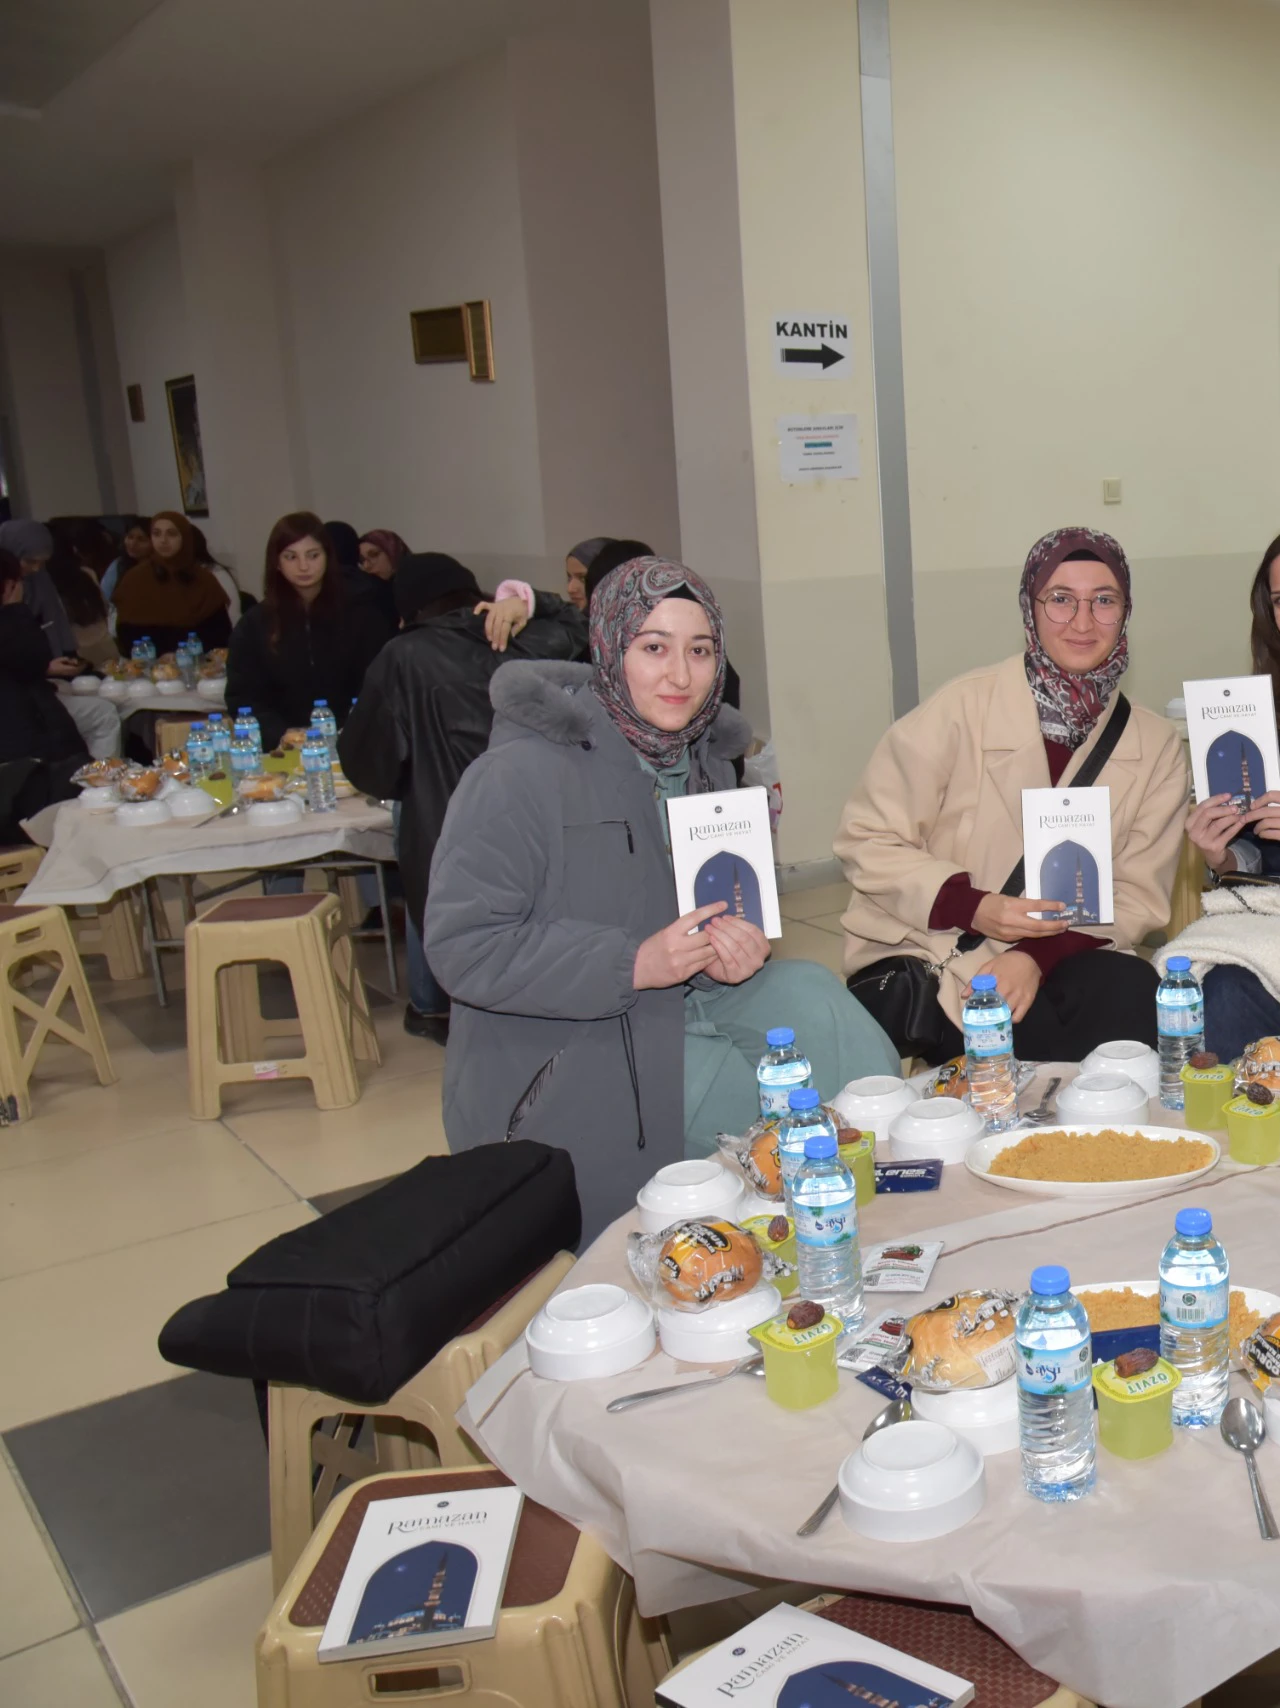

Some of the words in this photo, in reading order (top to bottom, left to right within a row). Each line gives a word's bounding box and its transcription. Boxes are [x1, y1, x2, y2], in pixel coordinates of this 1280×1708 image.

[776, 320, 848, 339] KANTİN
[1201, 704, 1256, 720] Ramazan
[689, 820, 752, 841] Ramazan
[1039, 813, 1095, 829] Ramazan
[1127, 1373, 1169, 1394] ÖZVİT
[387, 1511, 488, 1535] Ramazan
[716, 1632, 805, 1699] Ramazan
